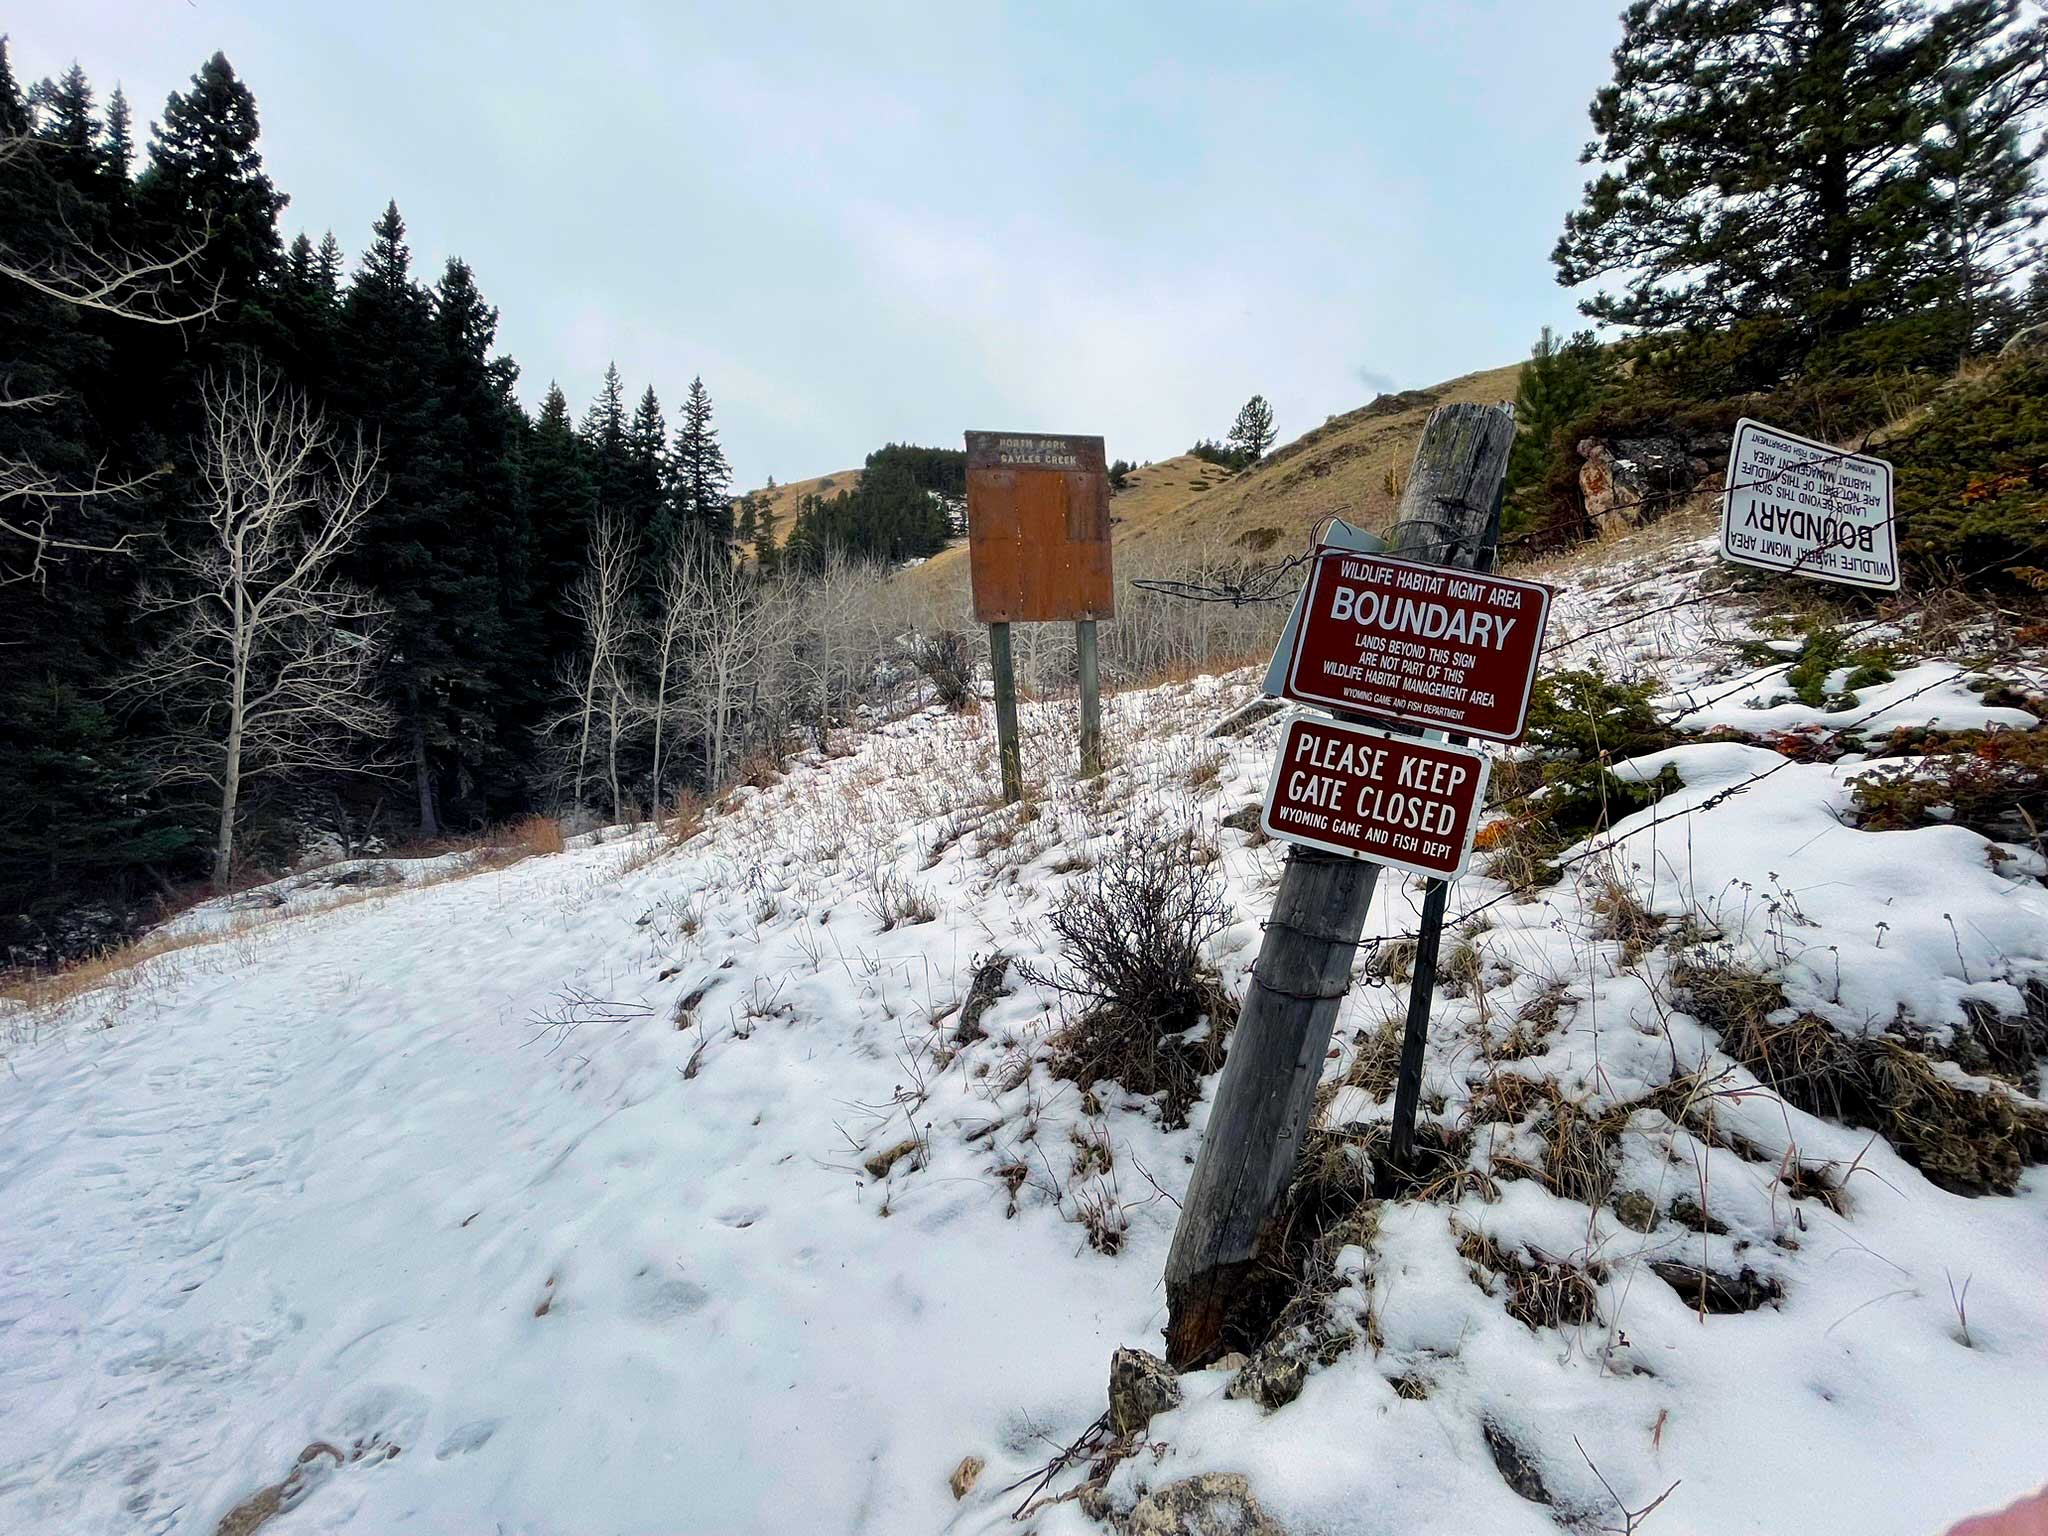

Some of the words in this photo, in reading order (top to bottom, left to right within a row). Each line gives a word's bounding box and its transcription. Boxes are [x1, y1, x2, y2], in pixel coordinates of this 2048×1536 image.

[1041, 440, 1066, 449] FORK
[1752, 434, 1791, 454] DEPARTMENT
[1794, 448, 1807, 458] FISH
[1046, 456, 1077, 464] CREEK
[1754, 450, 1775, 467] AREA
[1810, 453, 1823, 461] AND
[1741, 462, 1777, 481] WILDLIFE
[1845, 462, 1876, 476] WYOMING
[1753, 480, 1773, 495] SIGN
[1782, 473, 1799, 488] THIS
[1803, 481, 1814, 492] OF
[1839, 475, 1871, 491] HABITAT
[1776, 487, 1794, 501] THIS
[1798, 493, 1833, 512] BEYOND
[1843, 490, 1859, 501] NOT
[1863, 495, 1880, 506] ARE
[1837, 501, 1866, 517] LANDS
[1744, 500, 1873, 553] BOUNDARY
[1731, 532, 1757, 550] AREA
[1760, 539, 1791, 559] MGMT
[1841, 556, 1890, 576] WILDLIFE
[1341, 560, 1393, 586] WILDLIFE
[1396, 571, 1445, 594] HABITAT
[1447, 580, 1486, 601] MGMT
[1488, 589, 1521, 609] AREA
[1330, 586, 1516, 650] BOUNDARY
[1355, 634, 1385, 651] LANDS
[1389, 641, 1425, 659] BEYOND
[1429, 647, 1450, 663] THIS
[1452, 652, 1476, 668] SIGN
[1359, 652, 1377, 666] ARE
[1380, 656, 1399, 671] NOT
[1402, 661, 1424, 676] PART
[1427, 665, 1441, 678] OF
[1444, 668, 1464, 684] THIS
[1323, 661, 1362, 681] WILDLIFE
[1365, 667, 1401, 688] HABITAT
[1403, 677, 1468, 702] MANAGEMENT
[1469, 691, 1494, 707] AREA
[1343, 687, 1372, 701] WYOMING
[1374, 694, 1392, 706] GAME
[1393, 698, 1406, 708] AND
[1407, 701, 1422, 712] FISH
[1423, 704, 1465, 720] DEPARTMENT
[1295, 733, 1389, 781] PLEASE
[1398, 756, 1466, 796] KEEP
[1288, 771, 1347, 811] GATE
[1356, 786, 1456, 836] CLOSED
[1280, 806, 1328, 830] WYOMING
[1332, 819, 1362, 838] GAME
[1365, 828, 1389, 844] AND
[1393, 834, 1419, 851] FISH
[1423, 843, 1452, 860] DEPT
